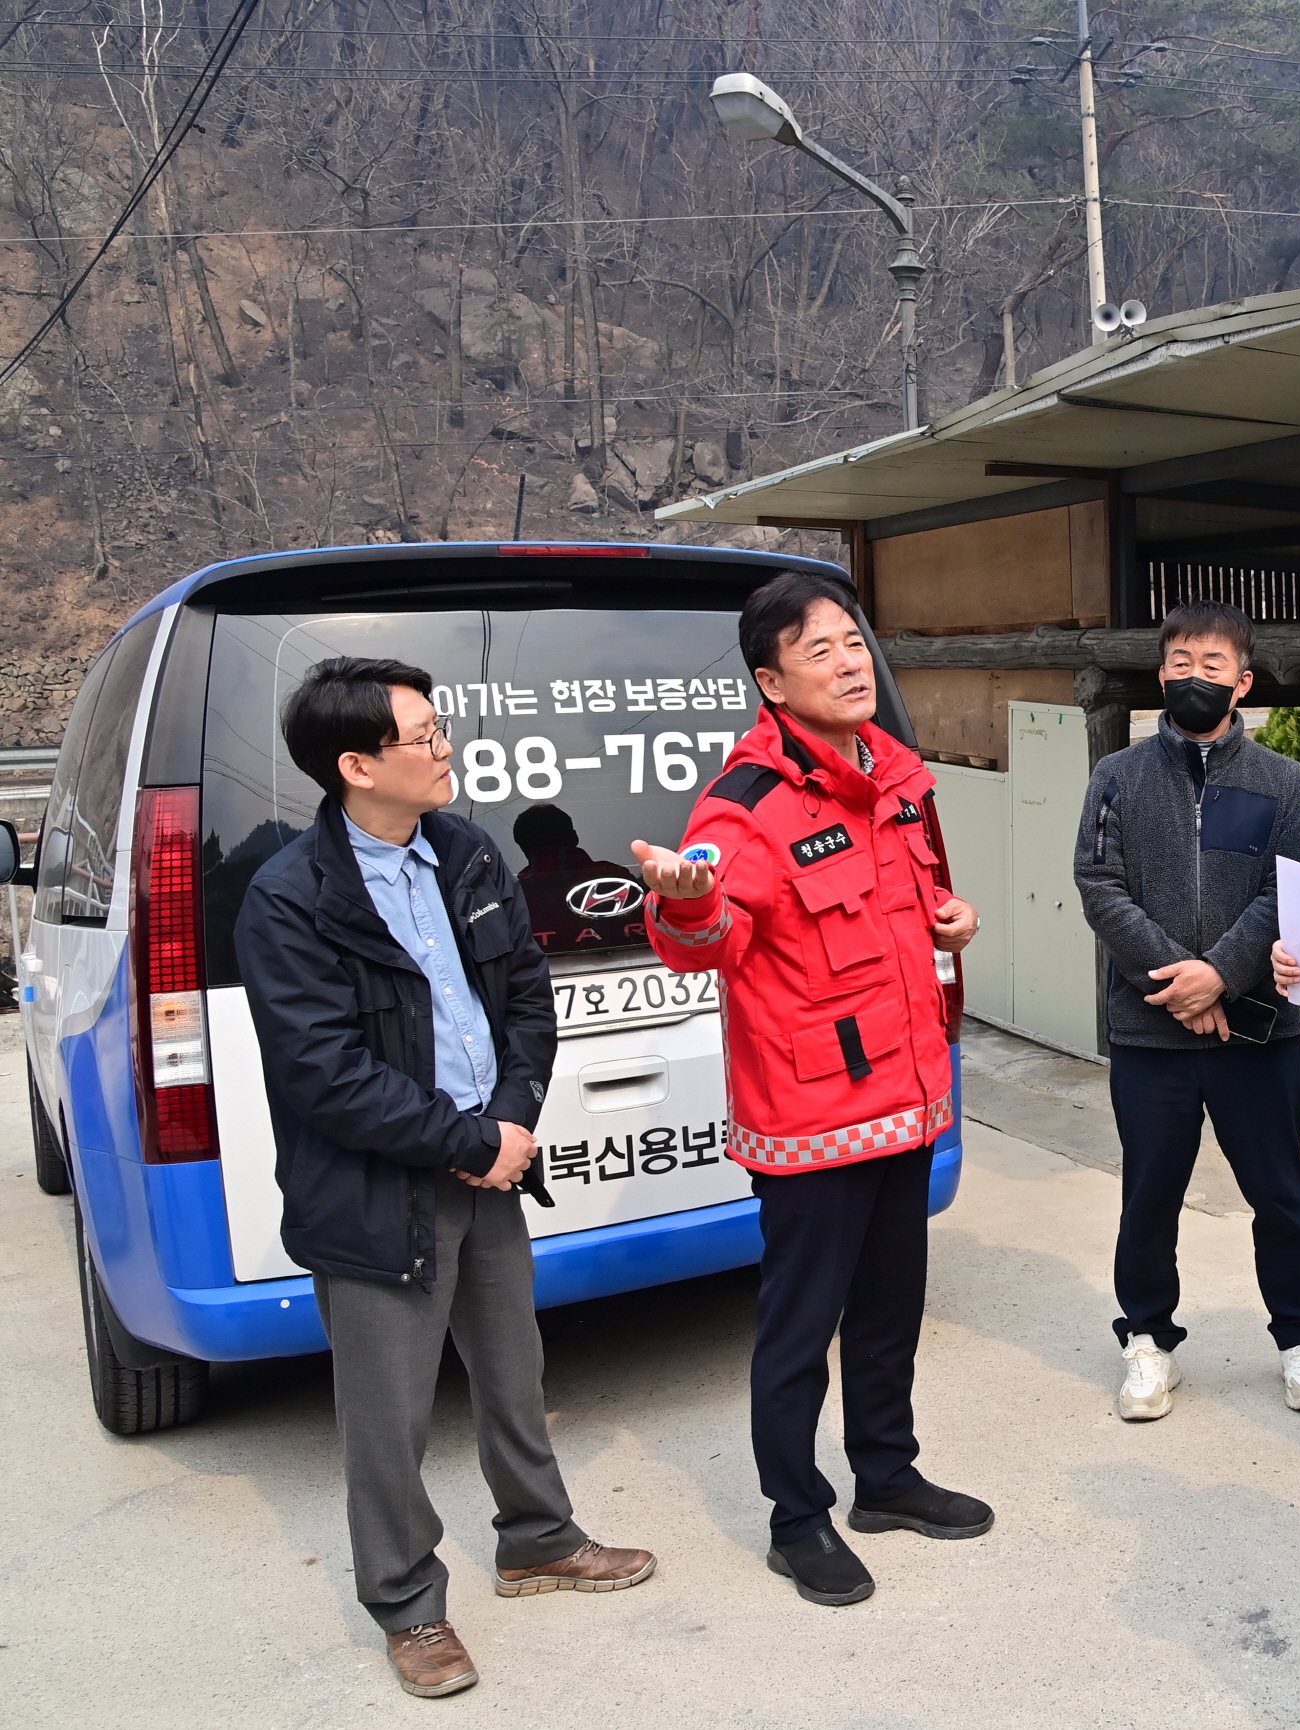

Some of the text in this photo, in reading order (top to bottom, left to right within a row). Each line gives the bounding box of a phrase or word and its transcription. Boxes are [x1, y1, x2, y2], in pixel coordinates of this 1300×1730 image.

[430, 678, 747, 718] 아가는 현장 보증상담
[449, 730, 750, 804] 88-767
[800, 831, 847, 858] 청송군수
[471, 901, 500, 921] Columbia
[617, 970, 716, 1013] 2032
[532, 1120, 729, 1186] 북신용보
